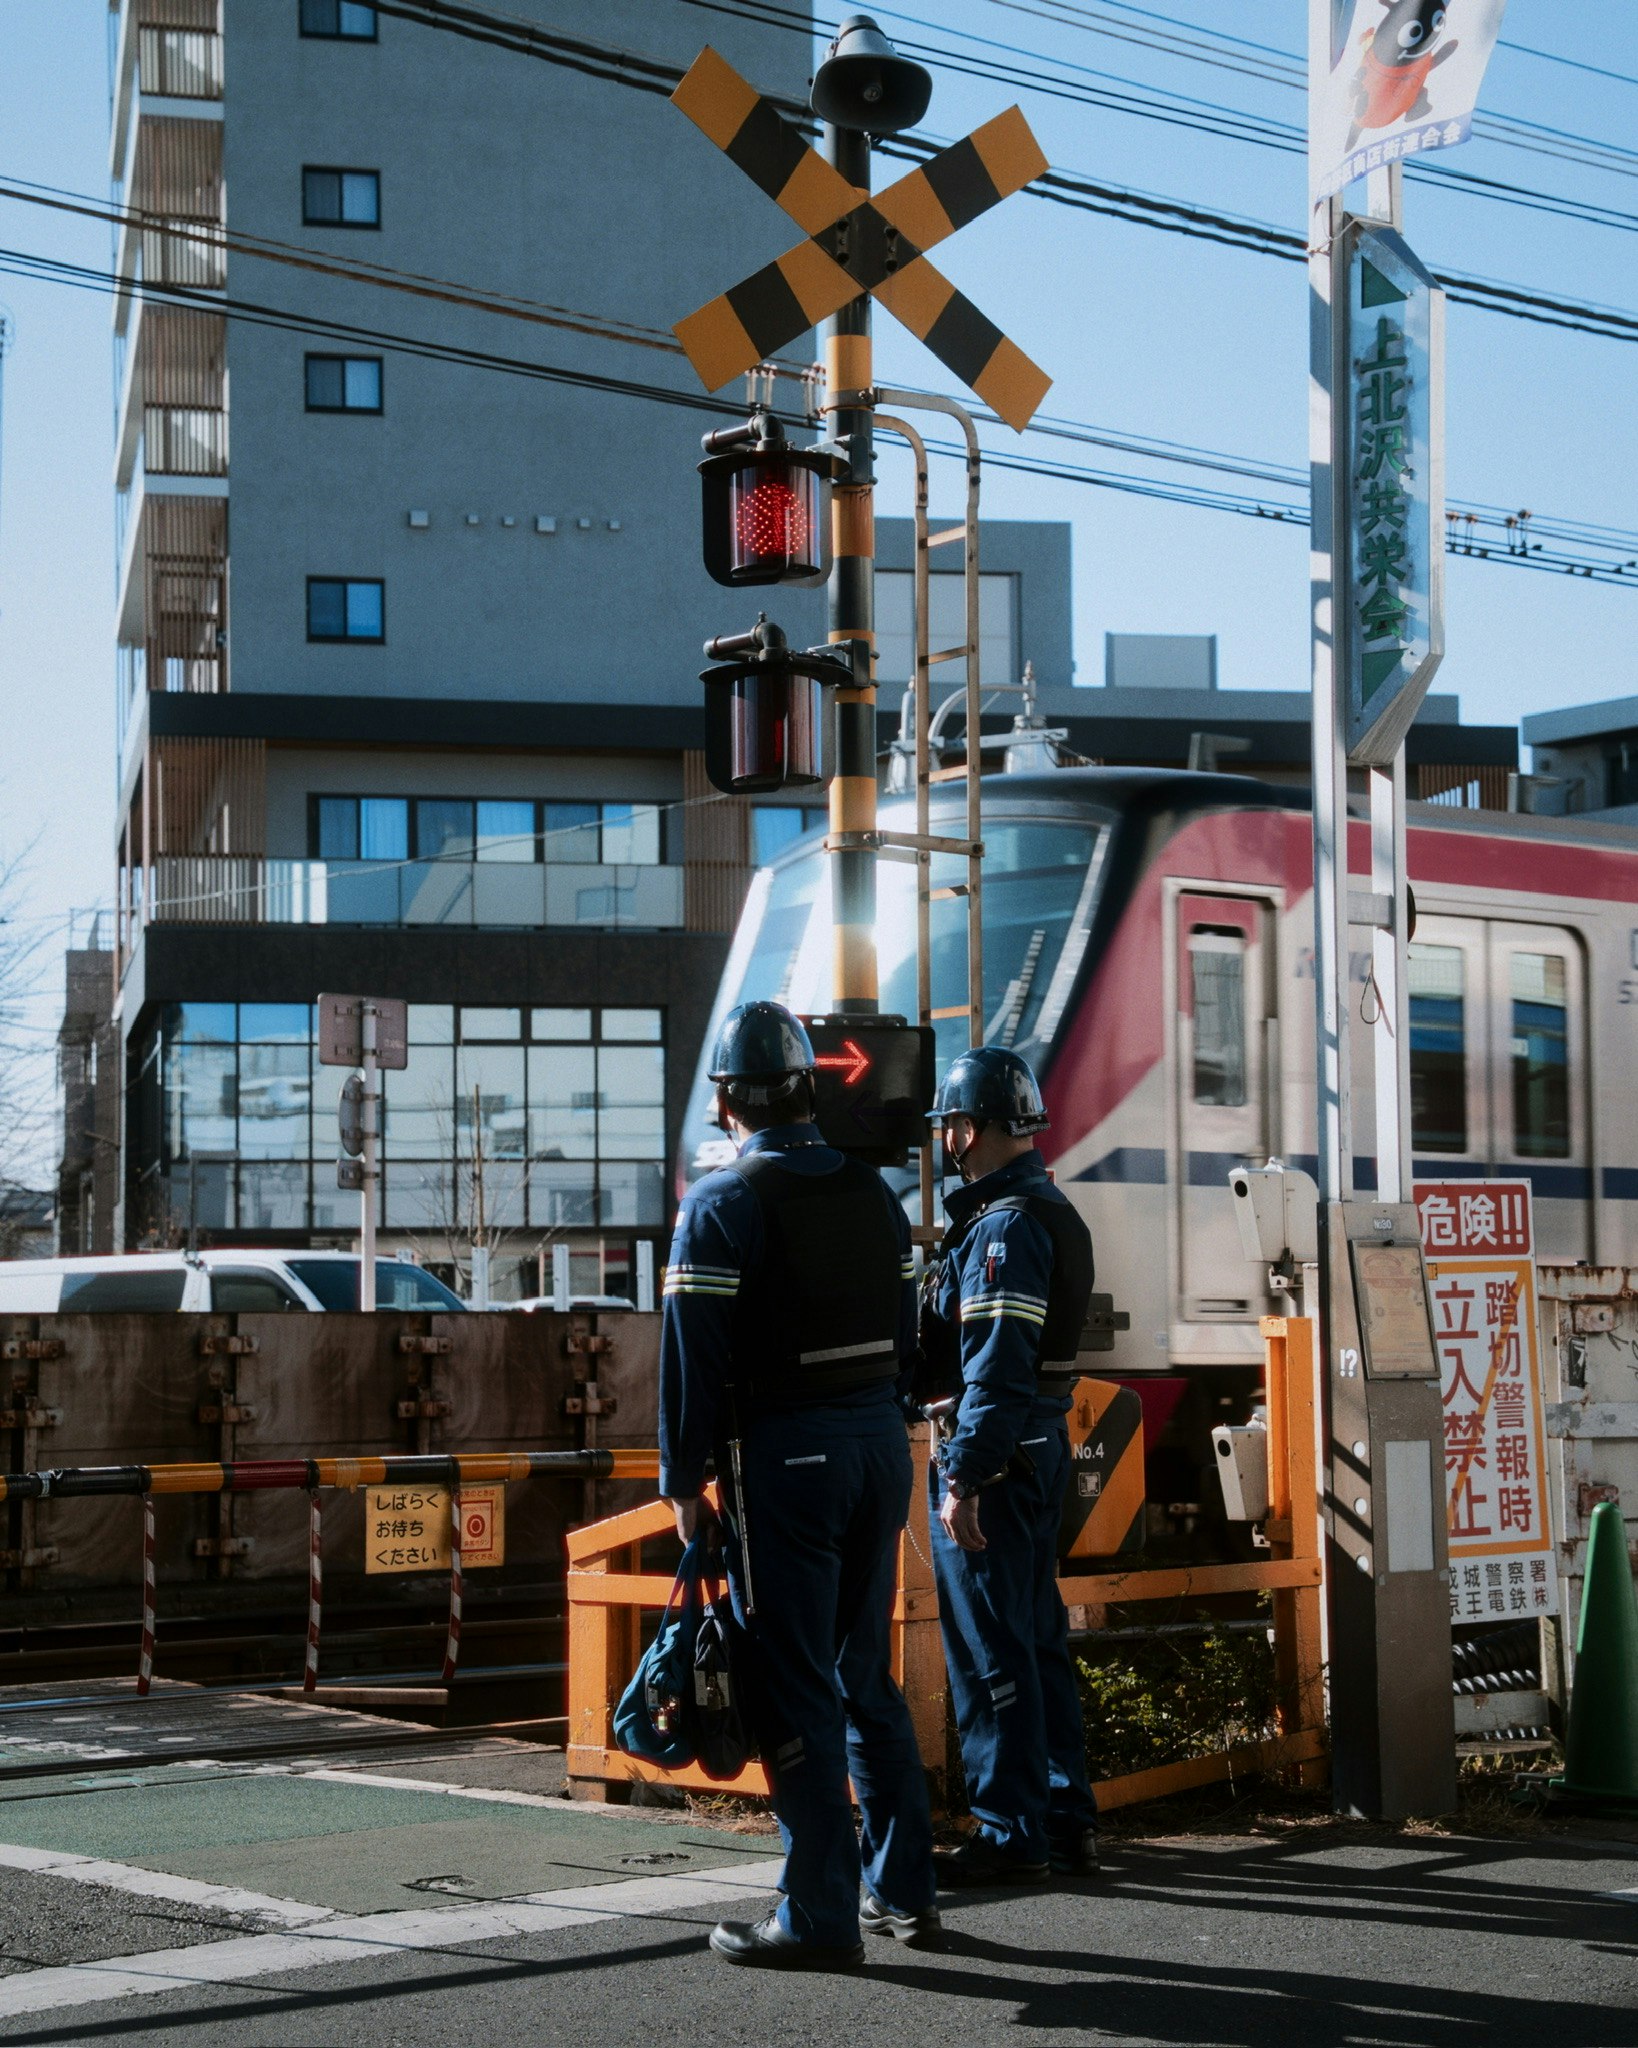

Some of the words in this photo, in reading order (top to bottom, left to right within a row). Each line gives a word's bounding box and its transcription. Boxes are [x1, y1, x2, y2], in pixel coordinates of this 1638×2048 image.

[1359, 318, 1407, 642] 上北沢共栄会
[1419, 1194, 1525, 1247] 危険!!
[1435, 1281, 1492, 1538] 立入禁止
[1485, 1281, 1533, 1533] 踏切警報時
[1073, 1442, 1105, 1460] No.4
[376, 1493, 438, 1511] しばらく
[460, 1489, 496, 1498] 常のときは
[376, 1520, 424, 1538] お待ち
[376, 1547, 437, 1566] ください
